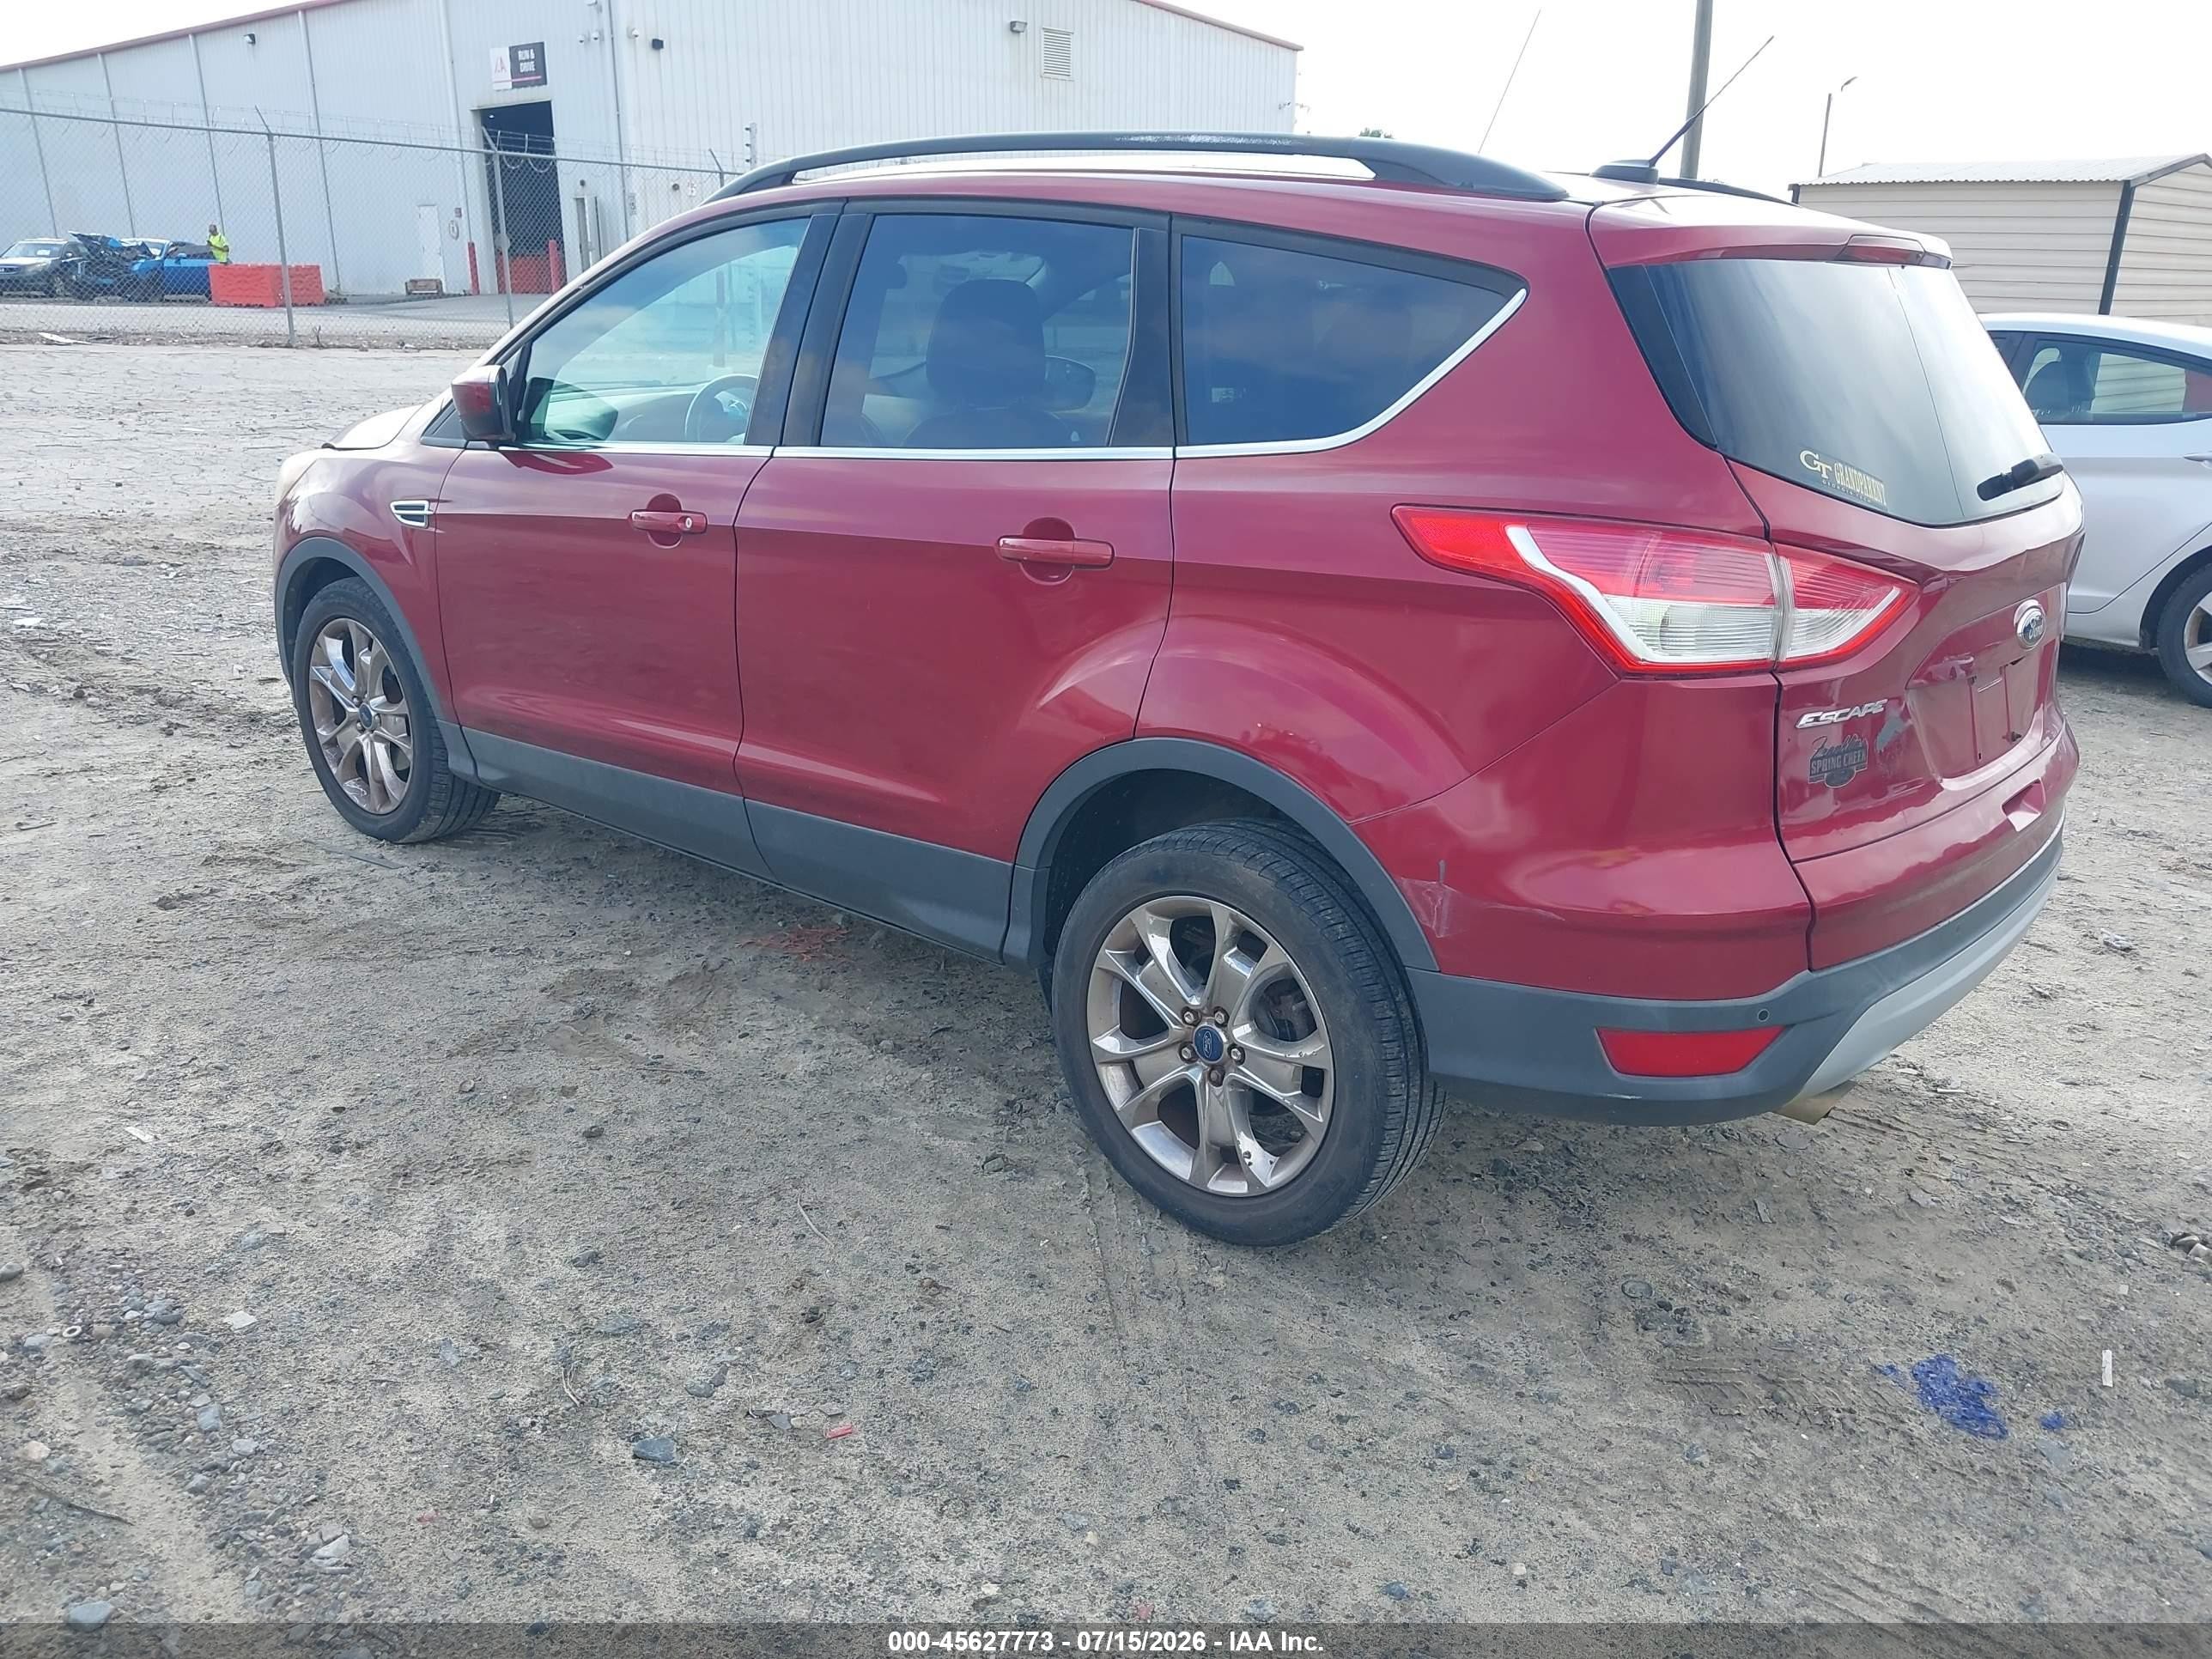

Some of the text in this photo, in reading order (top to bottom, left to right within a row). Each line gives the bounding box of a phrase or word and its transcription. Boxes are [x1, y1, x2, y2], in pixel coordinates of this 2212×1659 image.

[1799, 450, 1832, 479] GT
[1833, 462, 1887, 506] GRANDPARENT
[1796, 698, 1888, 729] ESCAPE
[1810, 748, 1867, 775] SPRING CREEK
